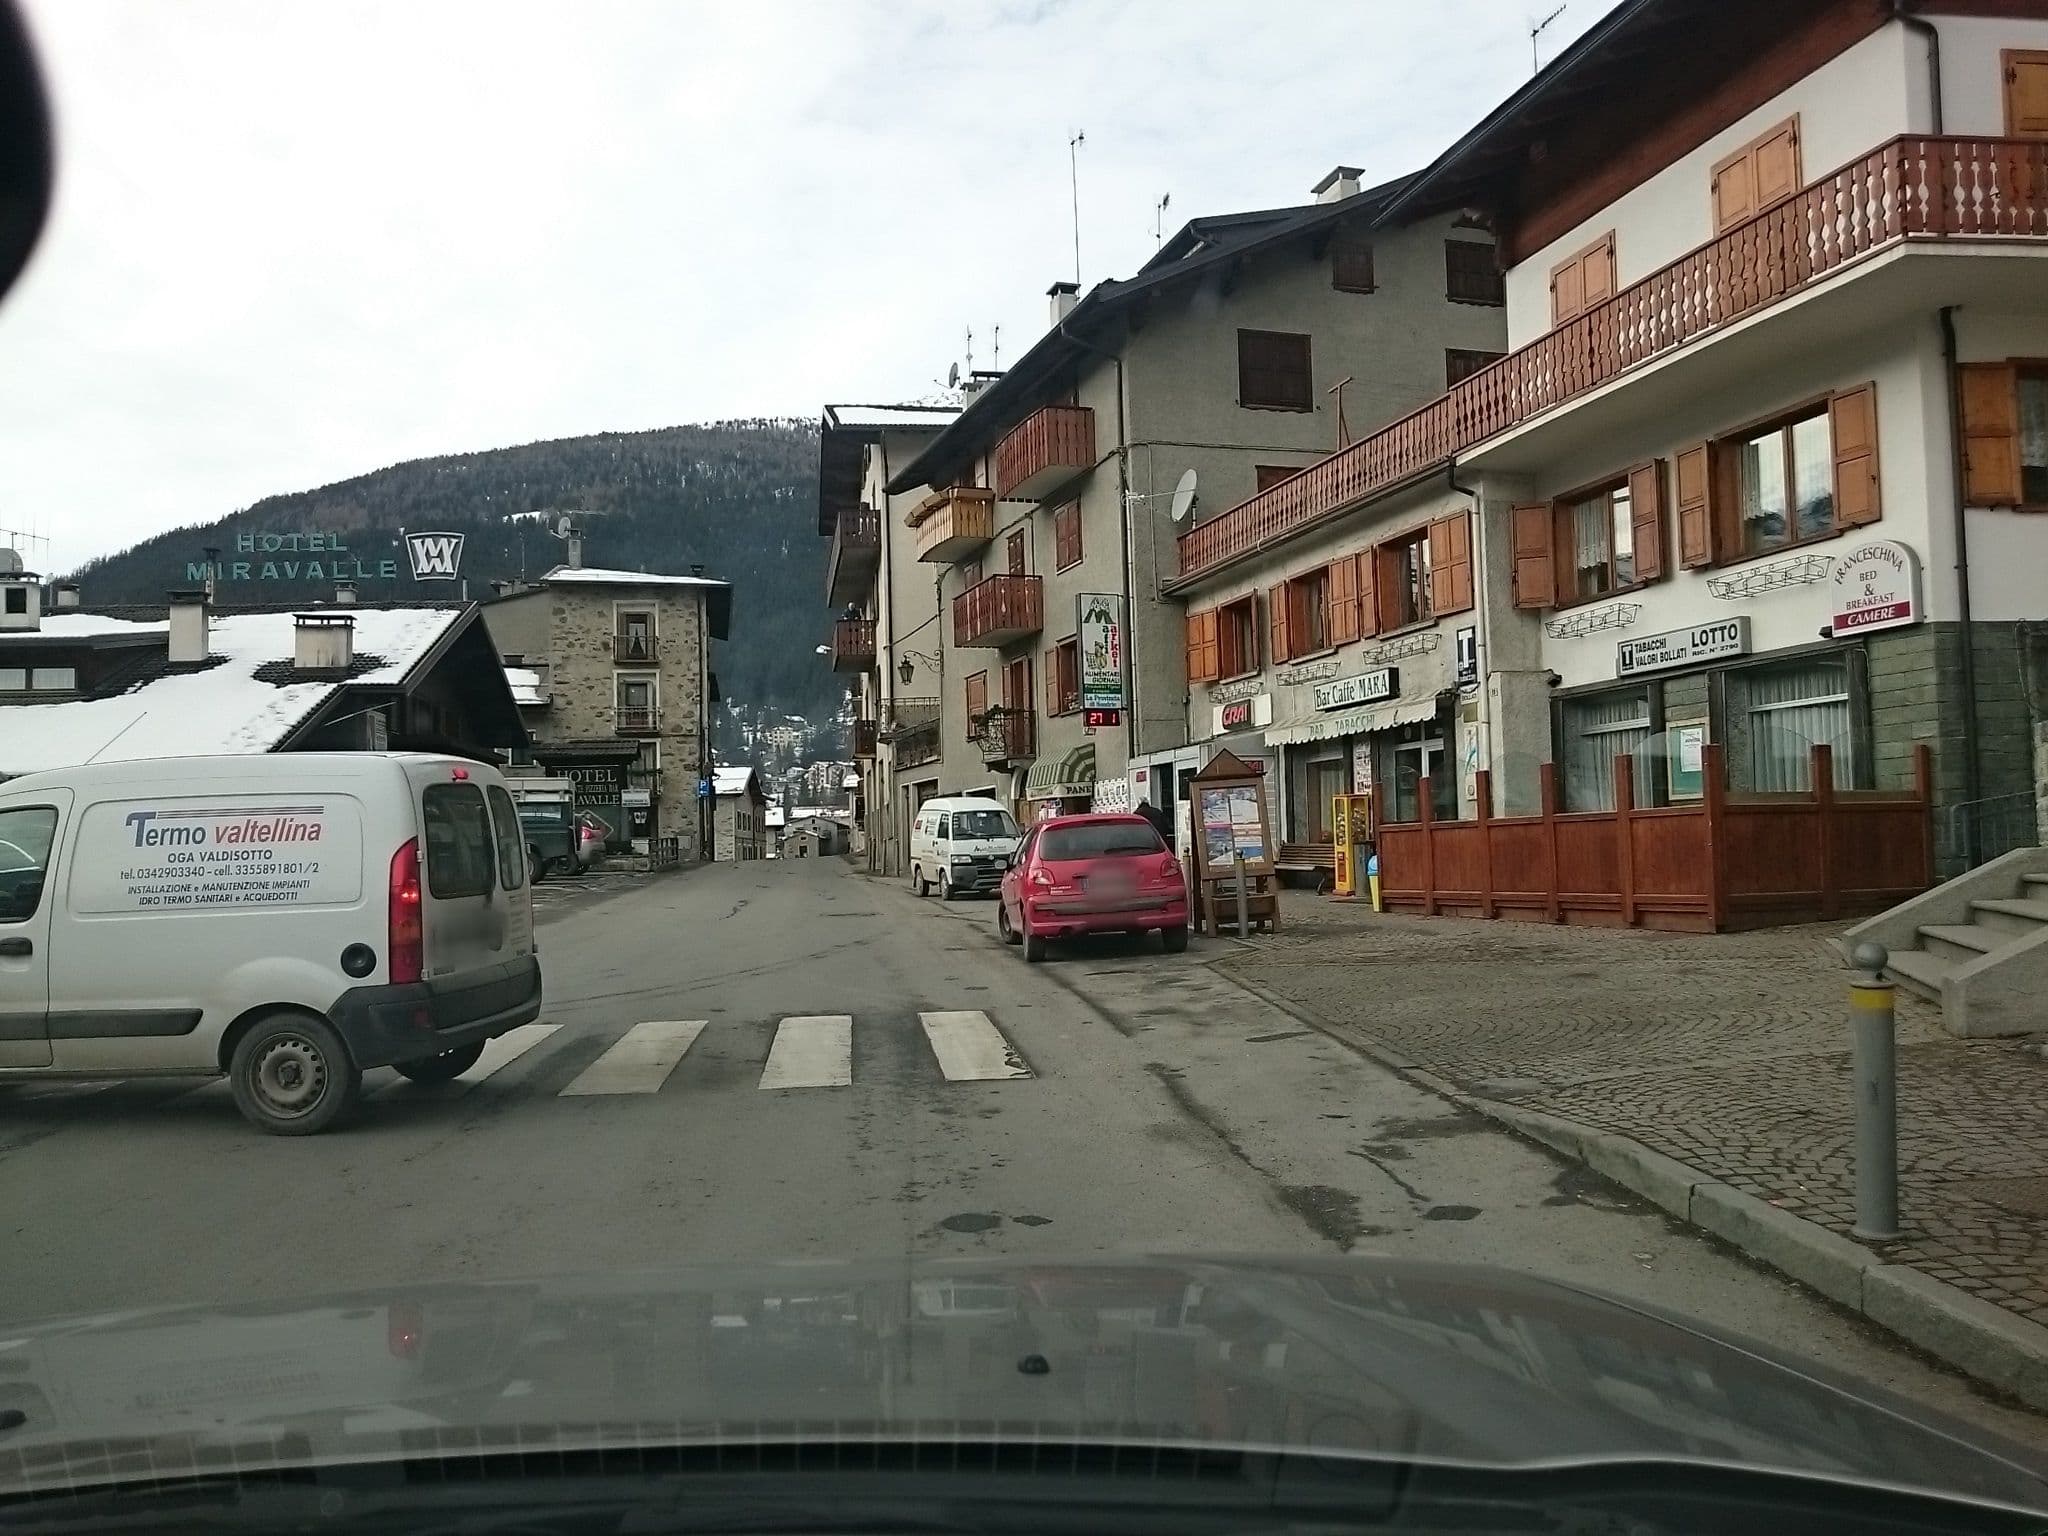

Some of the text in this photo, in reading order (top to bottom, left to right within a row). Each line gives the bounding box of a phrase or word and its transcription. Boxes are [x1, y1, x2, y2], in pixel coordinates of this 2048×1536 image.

[237, 533, 348, 552] HOTEL
[186, 560, 398, 580] MIRAVALLE
[1834, 546, 1904, 585] FRANCESCHINA
[1859, 570, 1877, 582] BED
[1864, 583, 1874, 596] &
[1846, 592, 1895, 611] BREAKFAST
[1847, 606, 1896, 626] CAMERE
[1691, 623, 1738, 648] LOTTO
[1634, 638, 1667, 654] TABACCHI
[1635, 647, 1687, 667] VALORI BOLLATI
[1315, 688, 1331, 707] Bar
[1358, 674, 1388, 698] MARA
[1090, 712, 1116, 724] 27 1
[1310, 714, 1375, 737] BAR TABACCHI
[557, 769, 617, 783] HOTEL
[1066, 785, 1092, 795] PANE
[125, 811, 323, 848] Termo valtellina
[167, 850, 273, 864] OGA VALDISOTTO
[120, 868, 135, 881] tel.
[136, 866, 205, 879] 0342903340
[235, 862, 320, 876] 3355891801/2
[128, 884, 194, 895] INSTALLAZIONE
[201, 881, 272, 892] MANUTENZIONE
[272, 880, 311, 890] IMPIANTI
[139, 896, 160, 906] IDRO
[163, 895, 193, 905] TERMO
[195, 893, 234, 904] SANITARI
[243, 892, 299, 903] ACQUEDOTTI
